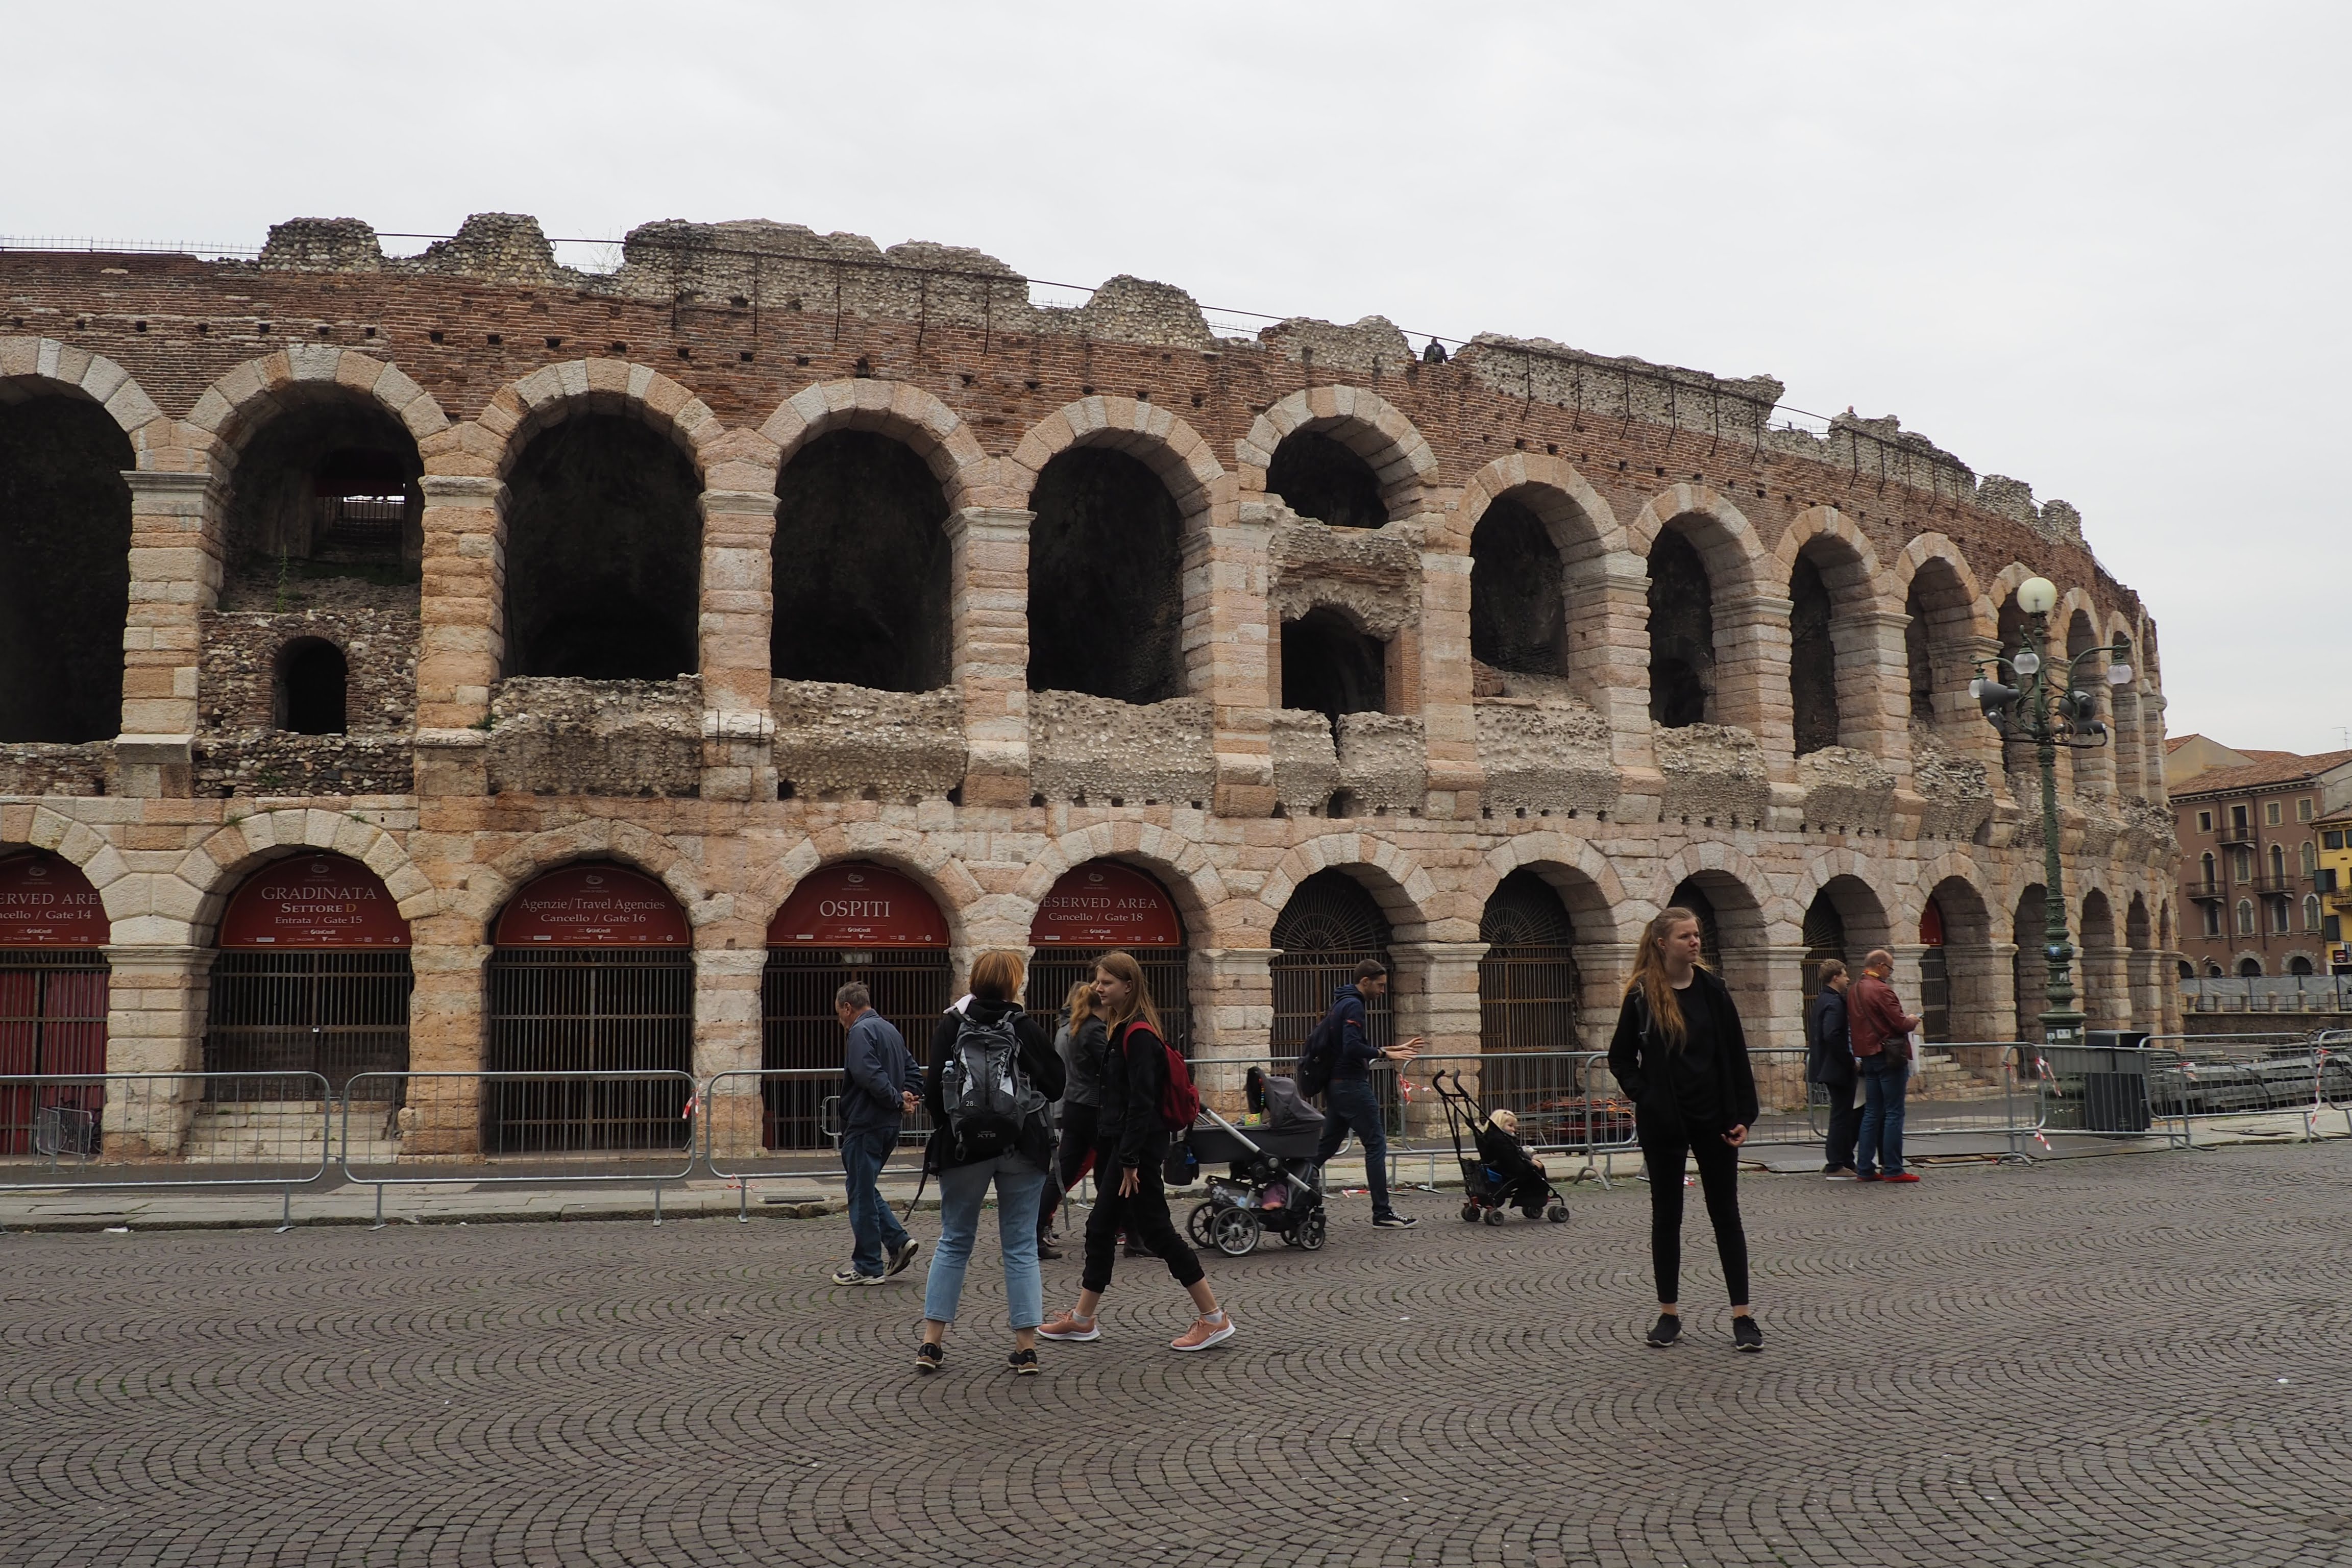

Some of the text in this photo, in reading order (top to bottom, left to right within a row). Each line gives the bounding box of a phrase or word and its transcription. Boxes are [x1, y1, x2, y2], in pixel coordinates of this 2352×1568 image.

[261, 887, 377, 900] GRADINATA
[346, 903, 356, 913] D
[614, 899, 666, 913] Agencies
[819, 900, 891, 917] OSPITI
[1038, 897, 1158, 909] ESERVED AREA
[45, 911, 74, 919] Gate
[77, 910, 92, 919] 14
[541, 914, 590, 922] Cancello
[603, 914, 630, 922] Gate
[632, 914, 646, 922] 16
[1048, 913, 1093, 921] Cancello
[1105, 913, 1129, 921] Gate
[1131, 913, 1143, 921] 18
